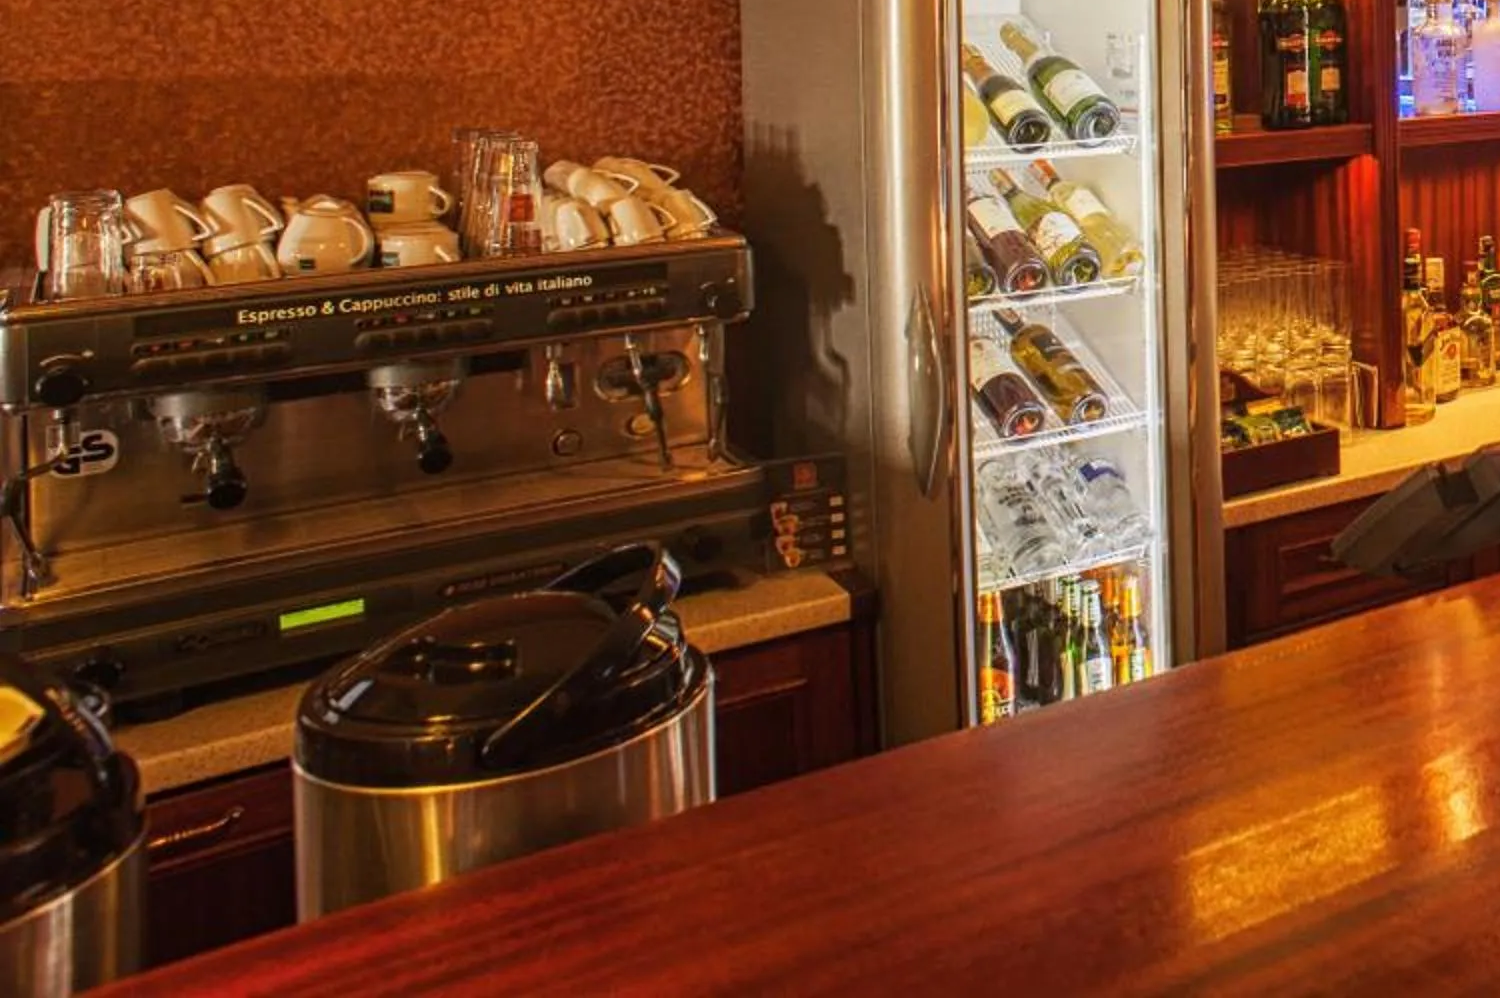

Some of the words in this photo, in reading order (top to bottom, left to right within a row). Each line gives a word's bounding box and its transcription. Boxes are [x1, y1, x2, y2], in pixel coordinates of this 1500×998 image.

[237, 304, 316, 325] Espresso
[321, 301, 335, 315] &
[338, 290, 442, 314] Cappuccino:
[447, 285, 481, 301] stile
[484, 281, 500, 298] di
[504, 279, 534, 295] vita
[537, 273, 593, 291] italiano
